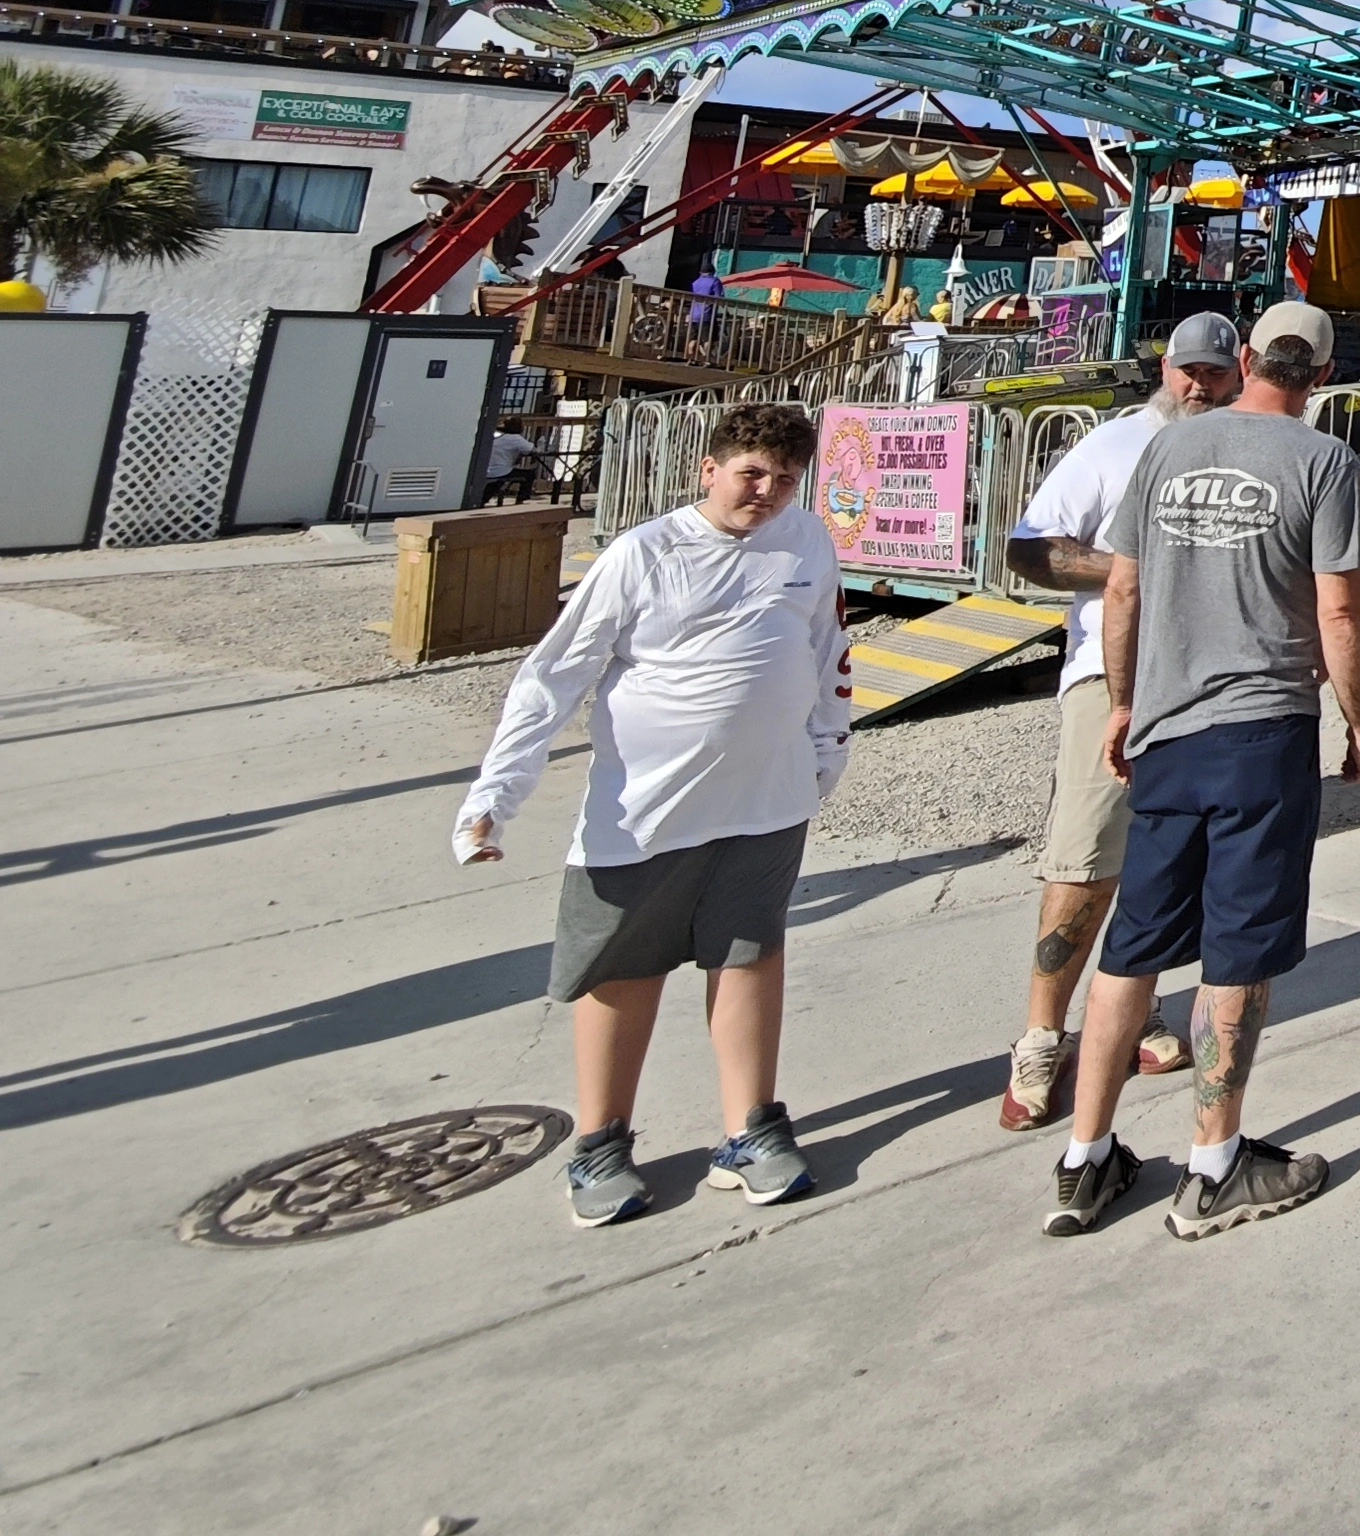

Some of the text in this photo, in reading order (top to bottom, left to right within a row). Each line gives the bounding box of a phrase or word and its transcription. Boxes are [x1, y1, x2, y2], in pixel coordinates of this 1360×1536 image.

[290, 110, 323, 120] COLD
[326, 113, 389, 125] COCKTAILS
[370, 106, 406, 119] EATS
[963, 267, 1016, 310] ILVER
[909, 416, 925, 431] OWN
[927, 414, 958, 431] DONUTS
[925, 434, 945, 452] OVER
[899, 453, 948, 470] POSSIBILITIES
[902, 474, 932, 491] WINNING
[911, 493, 937, 509] COFFEE
[1164, 477, 1263, 508] MLC
[884, 542, 901, 558] LAKE
[901, 543, 920, 560] PARK
[921, 544, 940, 561] BLVD
[942, 544, 954, 561] C3
